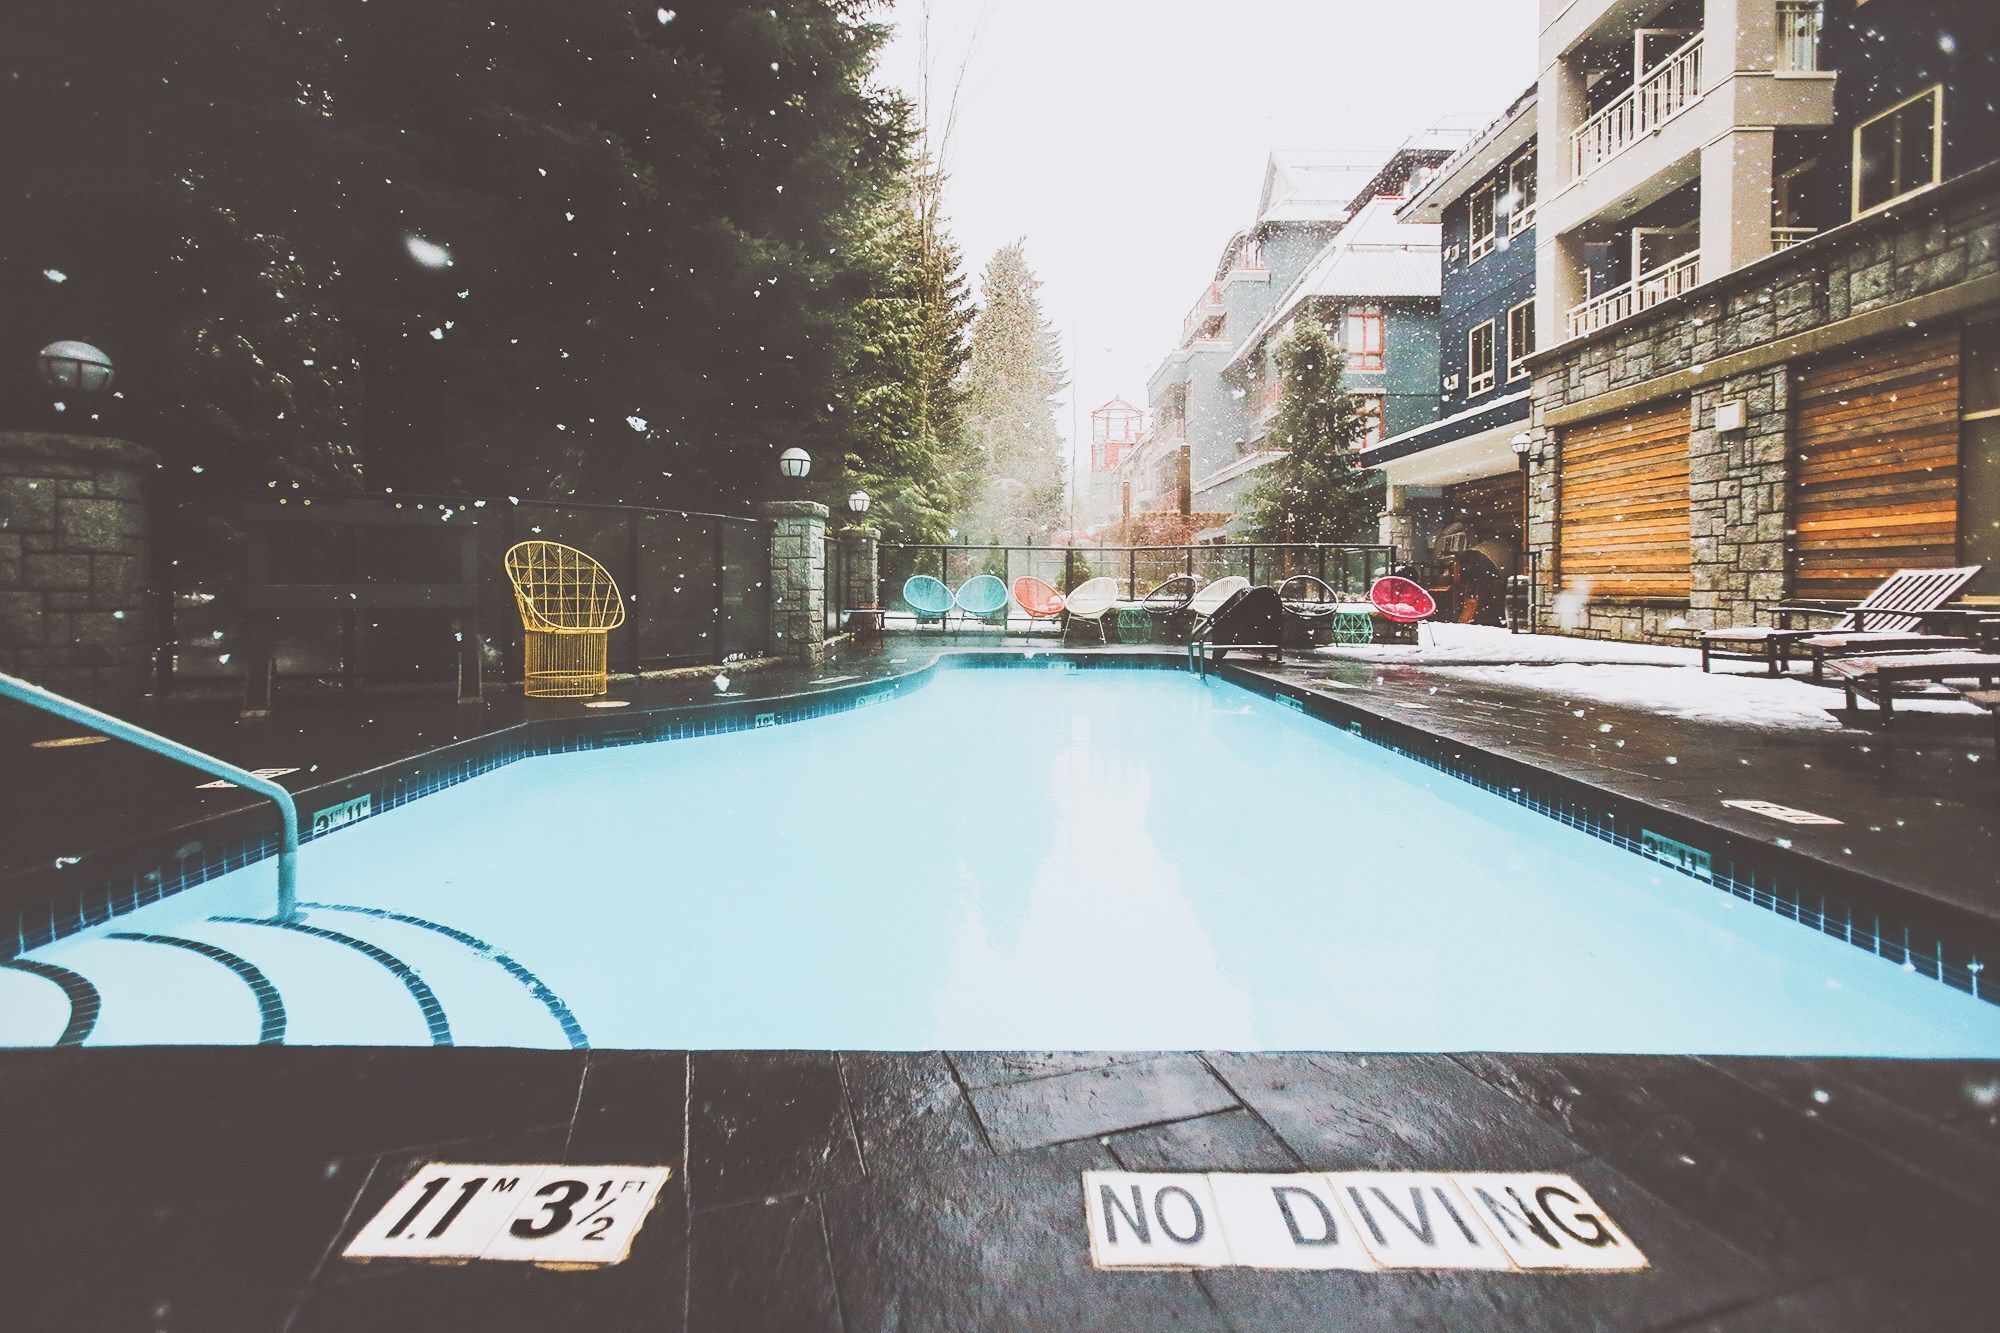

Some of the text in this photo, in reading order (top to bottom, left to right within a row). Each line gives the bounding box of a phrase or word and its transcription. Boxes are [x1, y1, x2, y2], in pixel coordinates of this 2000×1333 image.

[491, 1177, 520, 1193] M
[620, 1180, 650, 1193] FT
[1100, 1184, 1620, 1249] NO DIVING
